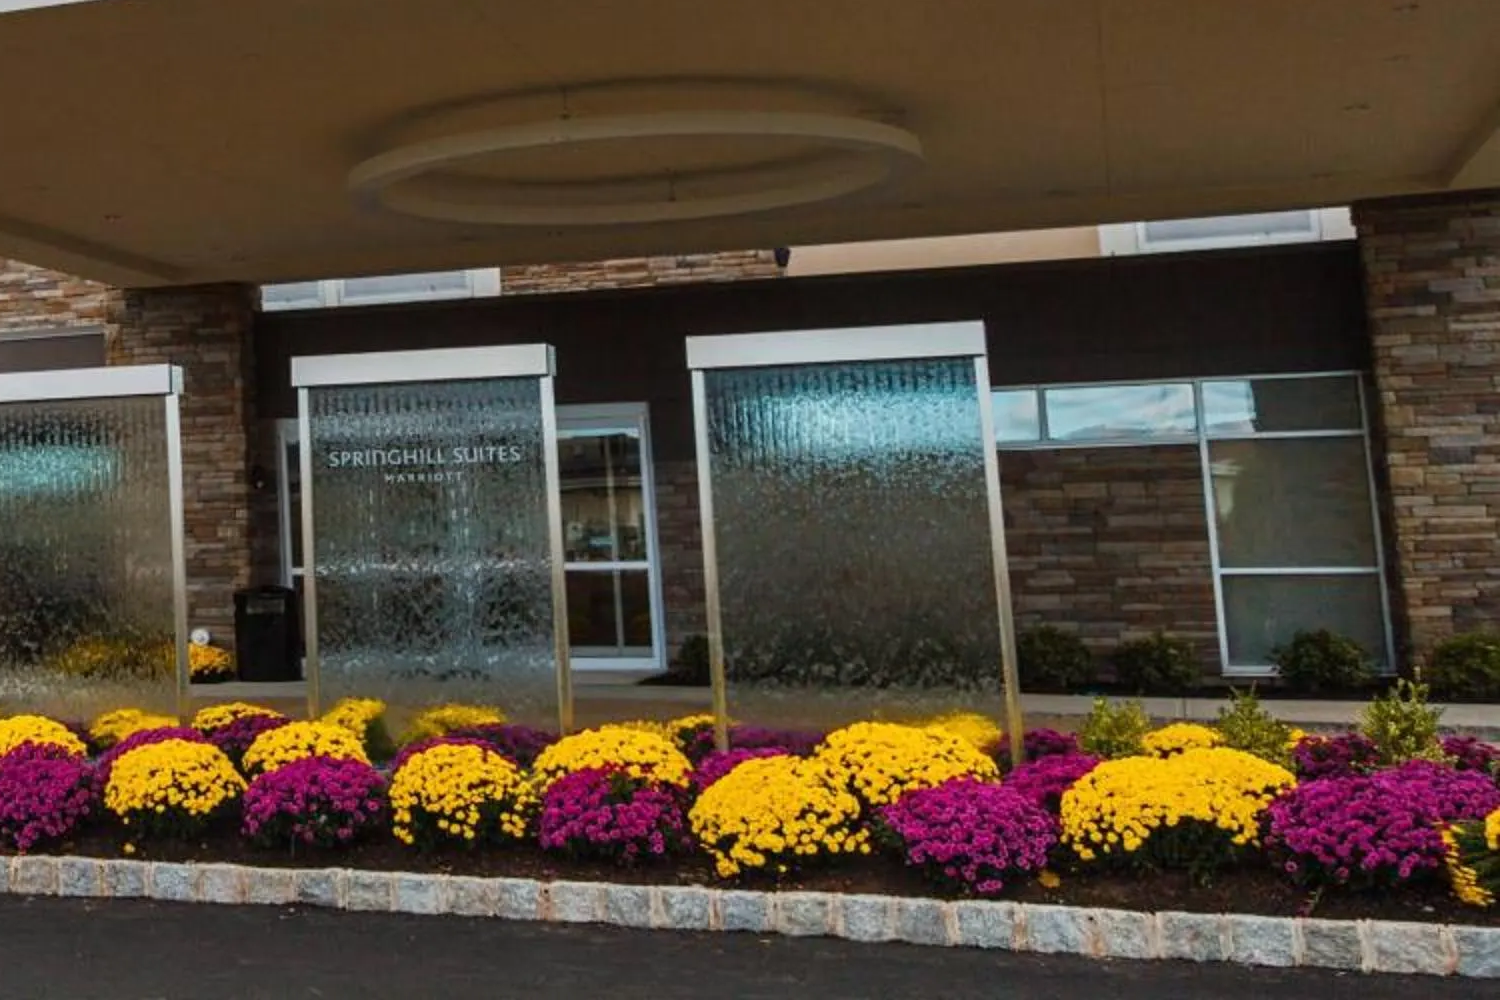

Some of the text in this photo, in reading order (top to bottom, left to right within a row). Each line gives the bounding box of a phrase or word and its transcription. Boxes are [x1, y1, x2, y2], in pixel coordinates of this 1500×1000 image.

[327, 446, 521, 468] SPRINGHILL SUITES
[384, 471, 464, 484] MARRIOTT
